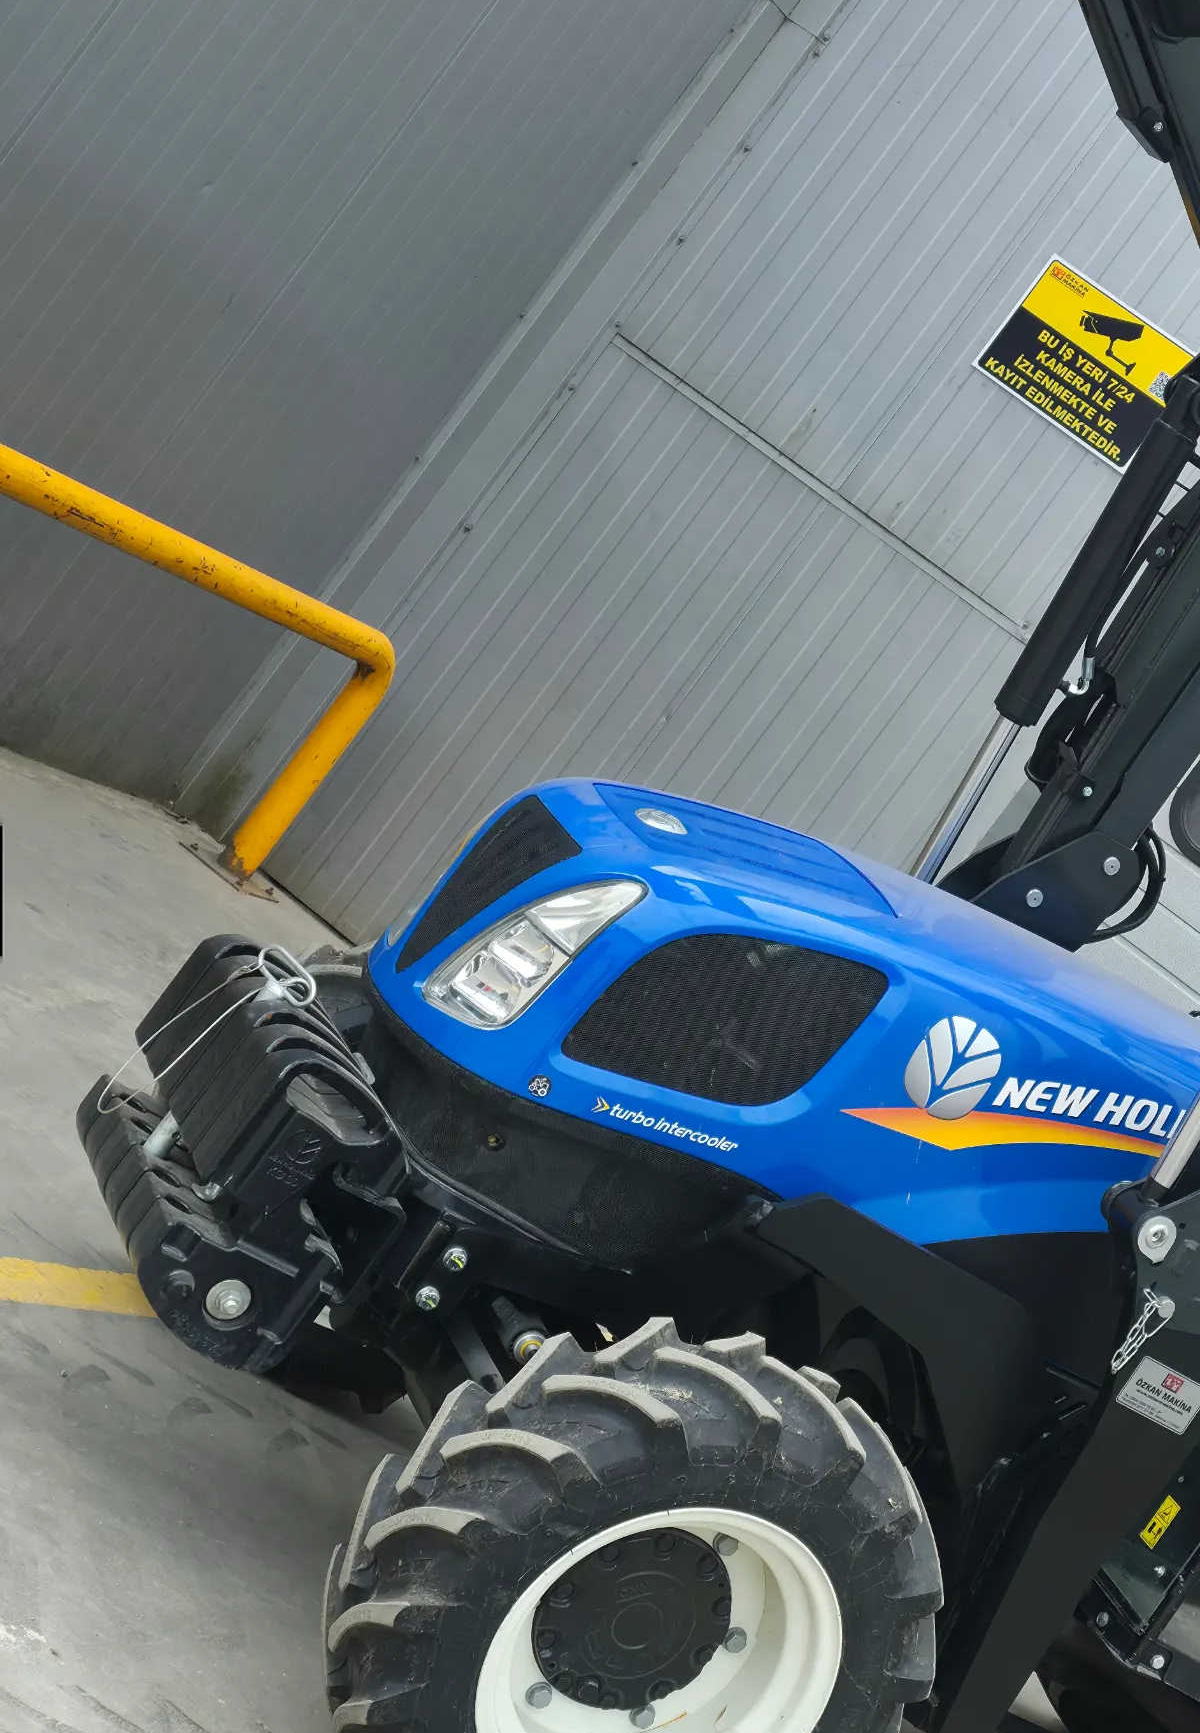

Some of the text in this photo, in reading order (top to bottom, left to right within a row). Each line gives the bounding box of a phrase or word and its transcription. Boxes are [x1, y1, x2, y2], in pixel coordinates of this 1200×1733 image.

[1013, 353, 1118, 435] İZLENMEKTE VE
[1035, 350, 1117, 412] KAMERA İLE
[1037, 329, 1136, 404] BU İŞ YERİ 7/24
[984, 356, 1121, 461] KAYIT EDİLMEKTEDİR.
[609, 1103, 739, 1152] turbo intercooler
[991, 1076, 1100, 1118] NEW
[1135, 1377, 1163, 1397] ÖZKAN
[1161, 1392, 1193, 1414] MAKİNA
